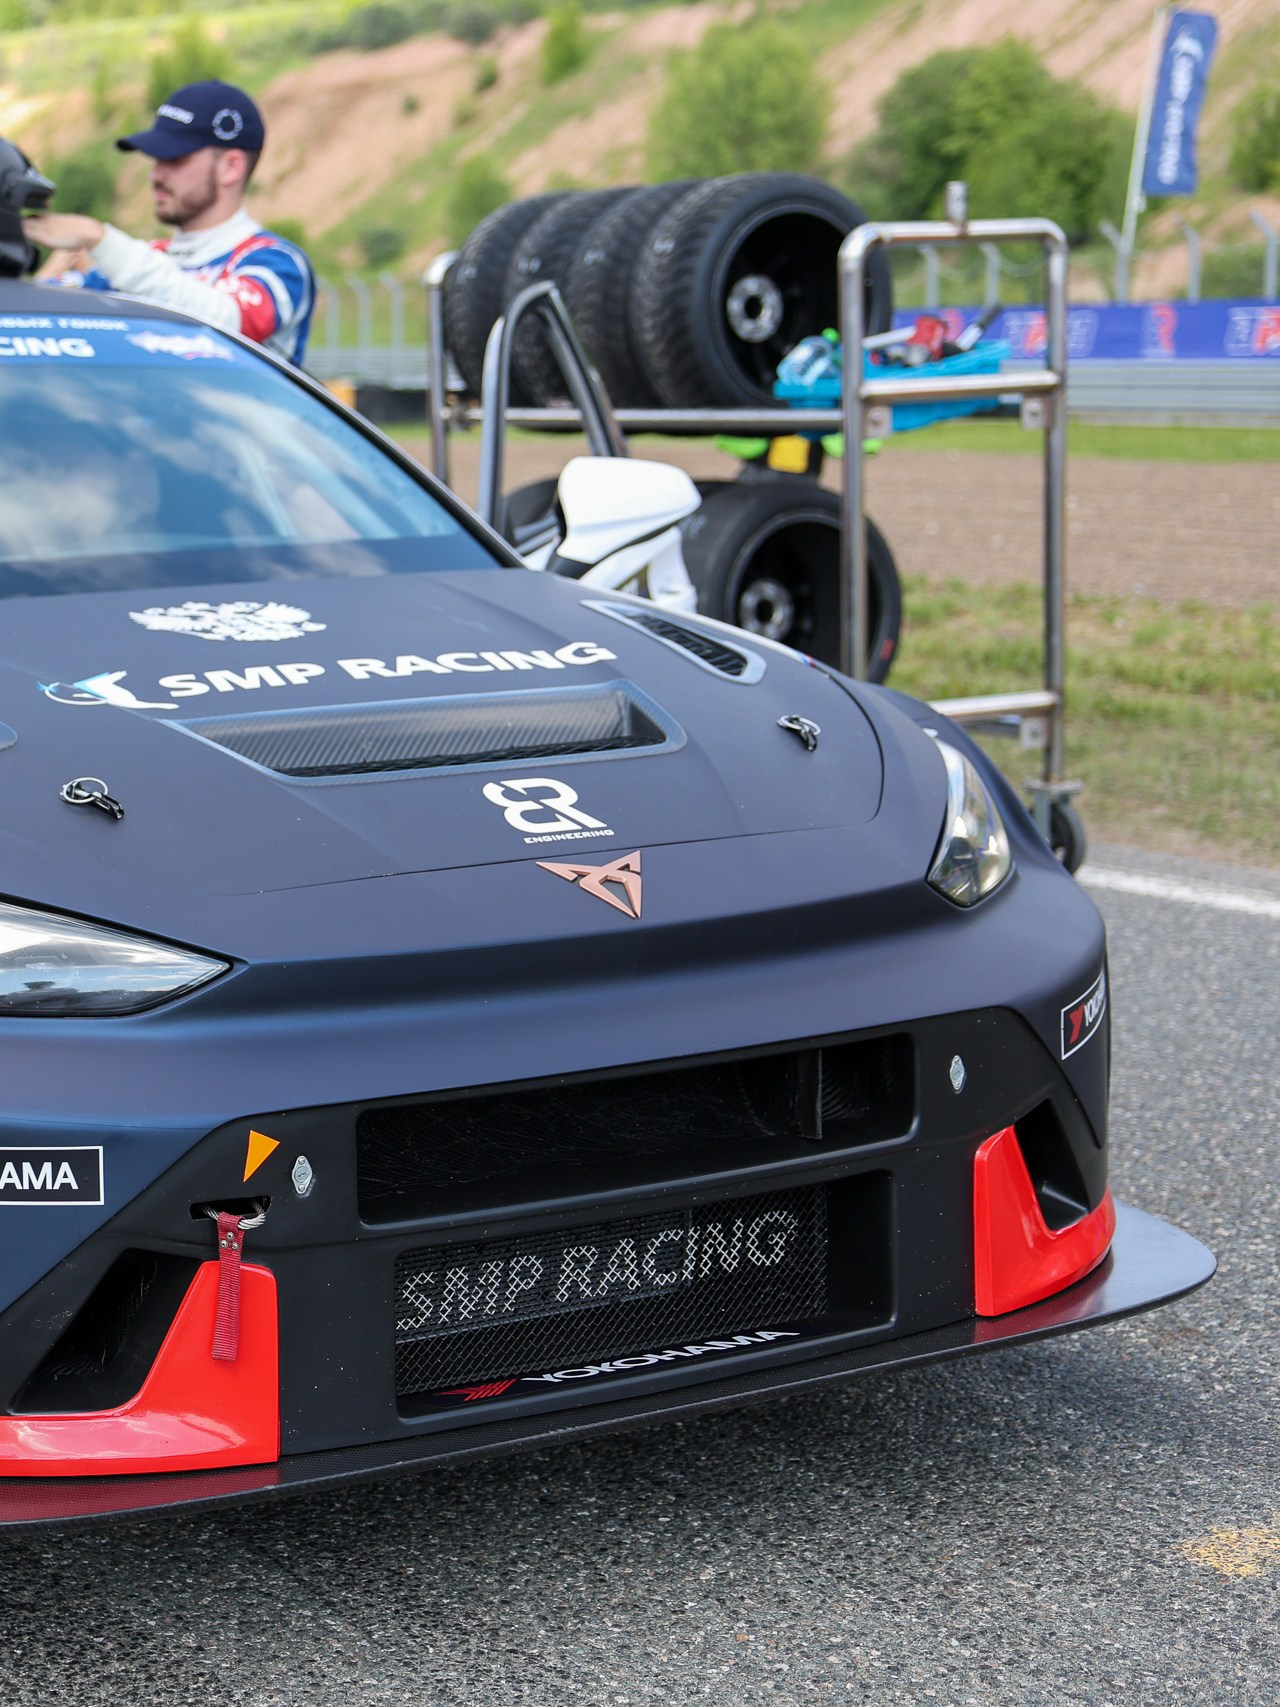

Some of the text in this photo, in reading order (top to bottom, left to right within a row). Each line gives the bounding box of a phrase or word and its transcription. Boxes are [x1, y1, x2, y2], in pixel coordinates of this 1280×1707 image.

[58, 317, 130, 332] гонок
[158, 641, 617, 698] SMP RACING
[523, 829, 615, 844] ENGINEERING
[396, 1210, 799, 1330] SMP RACING
[520, 1330, 801, 1383] YOKOHAMA
